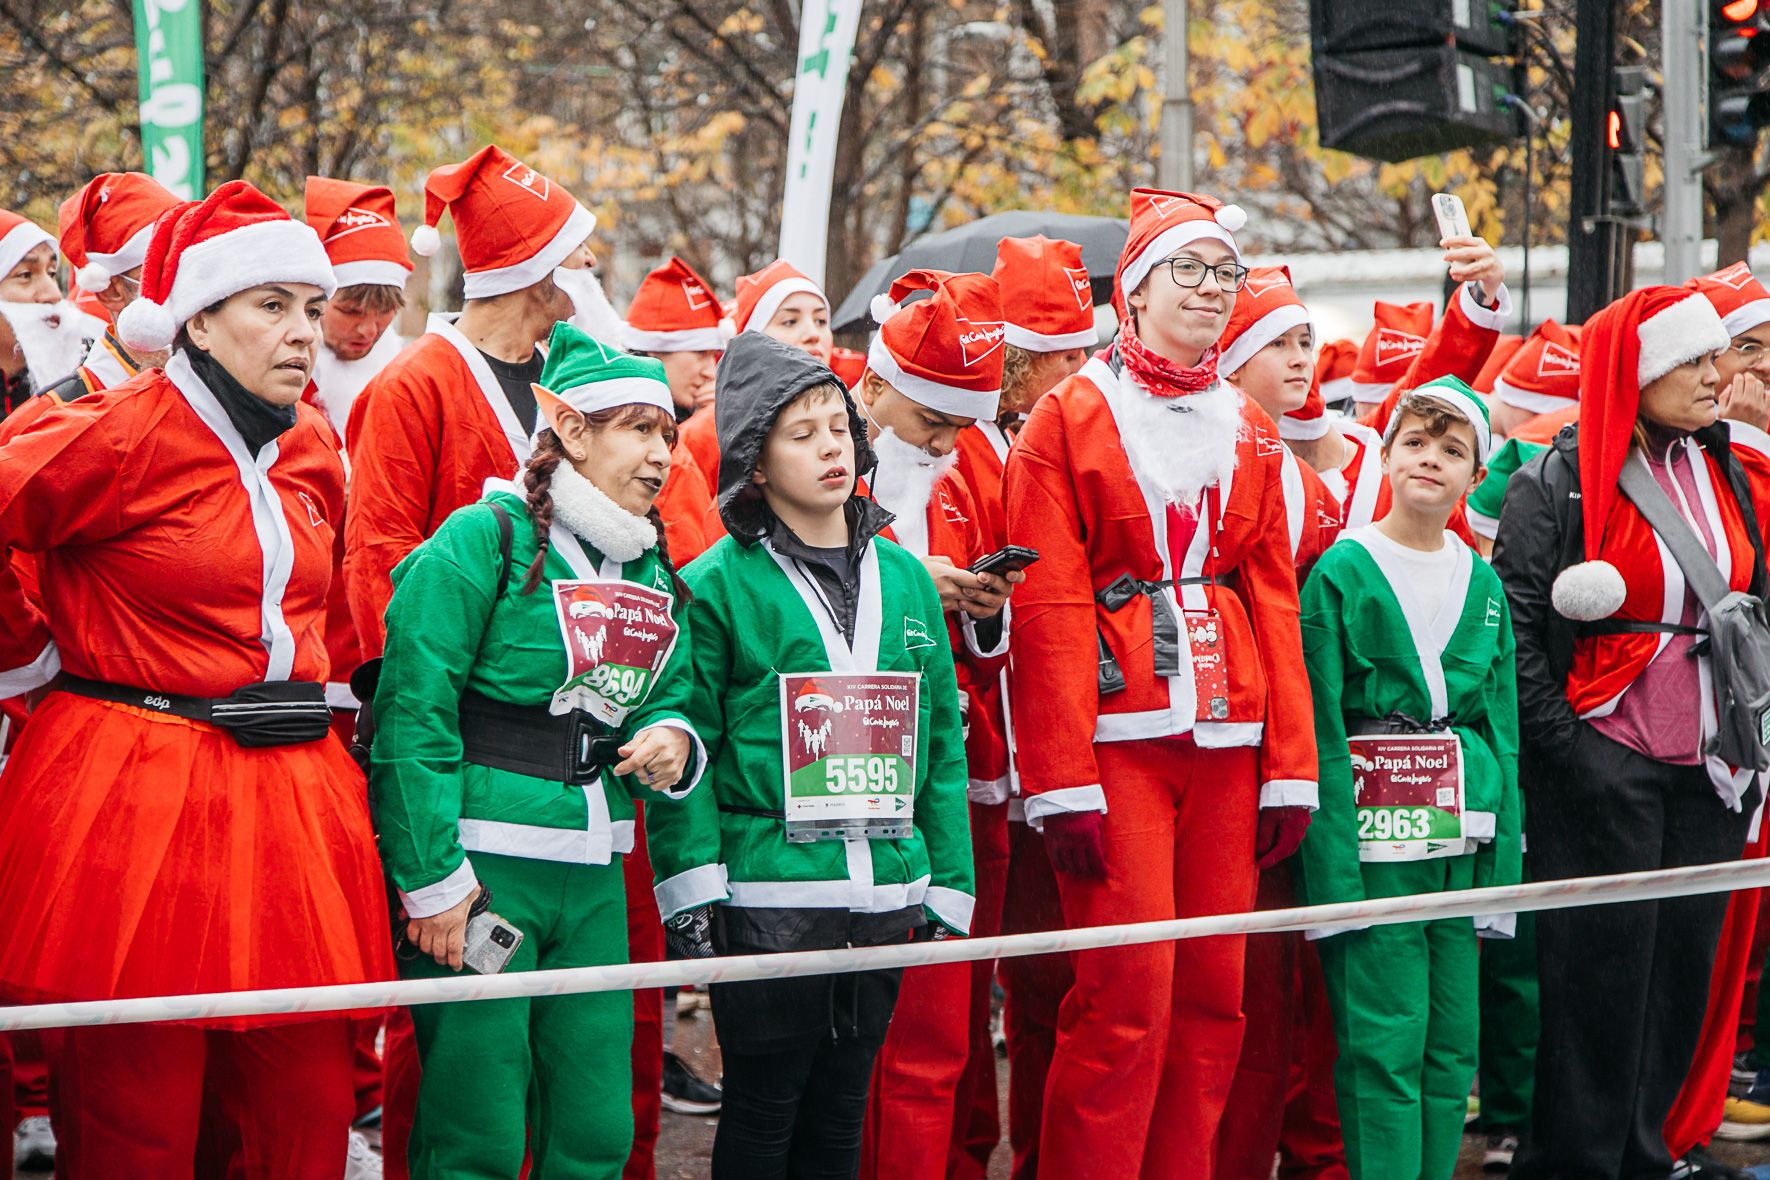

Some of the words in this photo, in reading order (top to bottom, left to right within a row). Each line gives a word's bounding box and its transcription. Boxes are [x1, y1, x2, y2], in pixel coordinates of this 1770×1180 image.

[613, 602, 643, 625] Papá
[644, 607, 669, 627] Noel
[582, 663, 647, 704] 8694
[143, 695, 171, 710] edp
[843, 694, 882, 715] Papá
[885, 695, 910, 711] Noel
[825, 757, 898, 793] 5595
[1374, 754, 1412, 773] Papá
[1415, 754, 1448, 769] Noel
[1357, 808, 1431, 840] 2963
